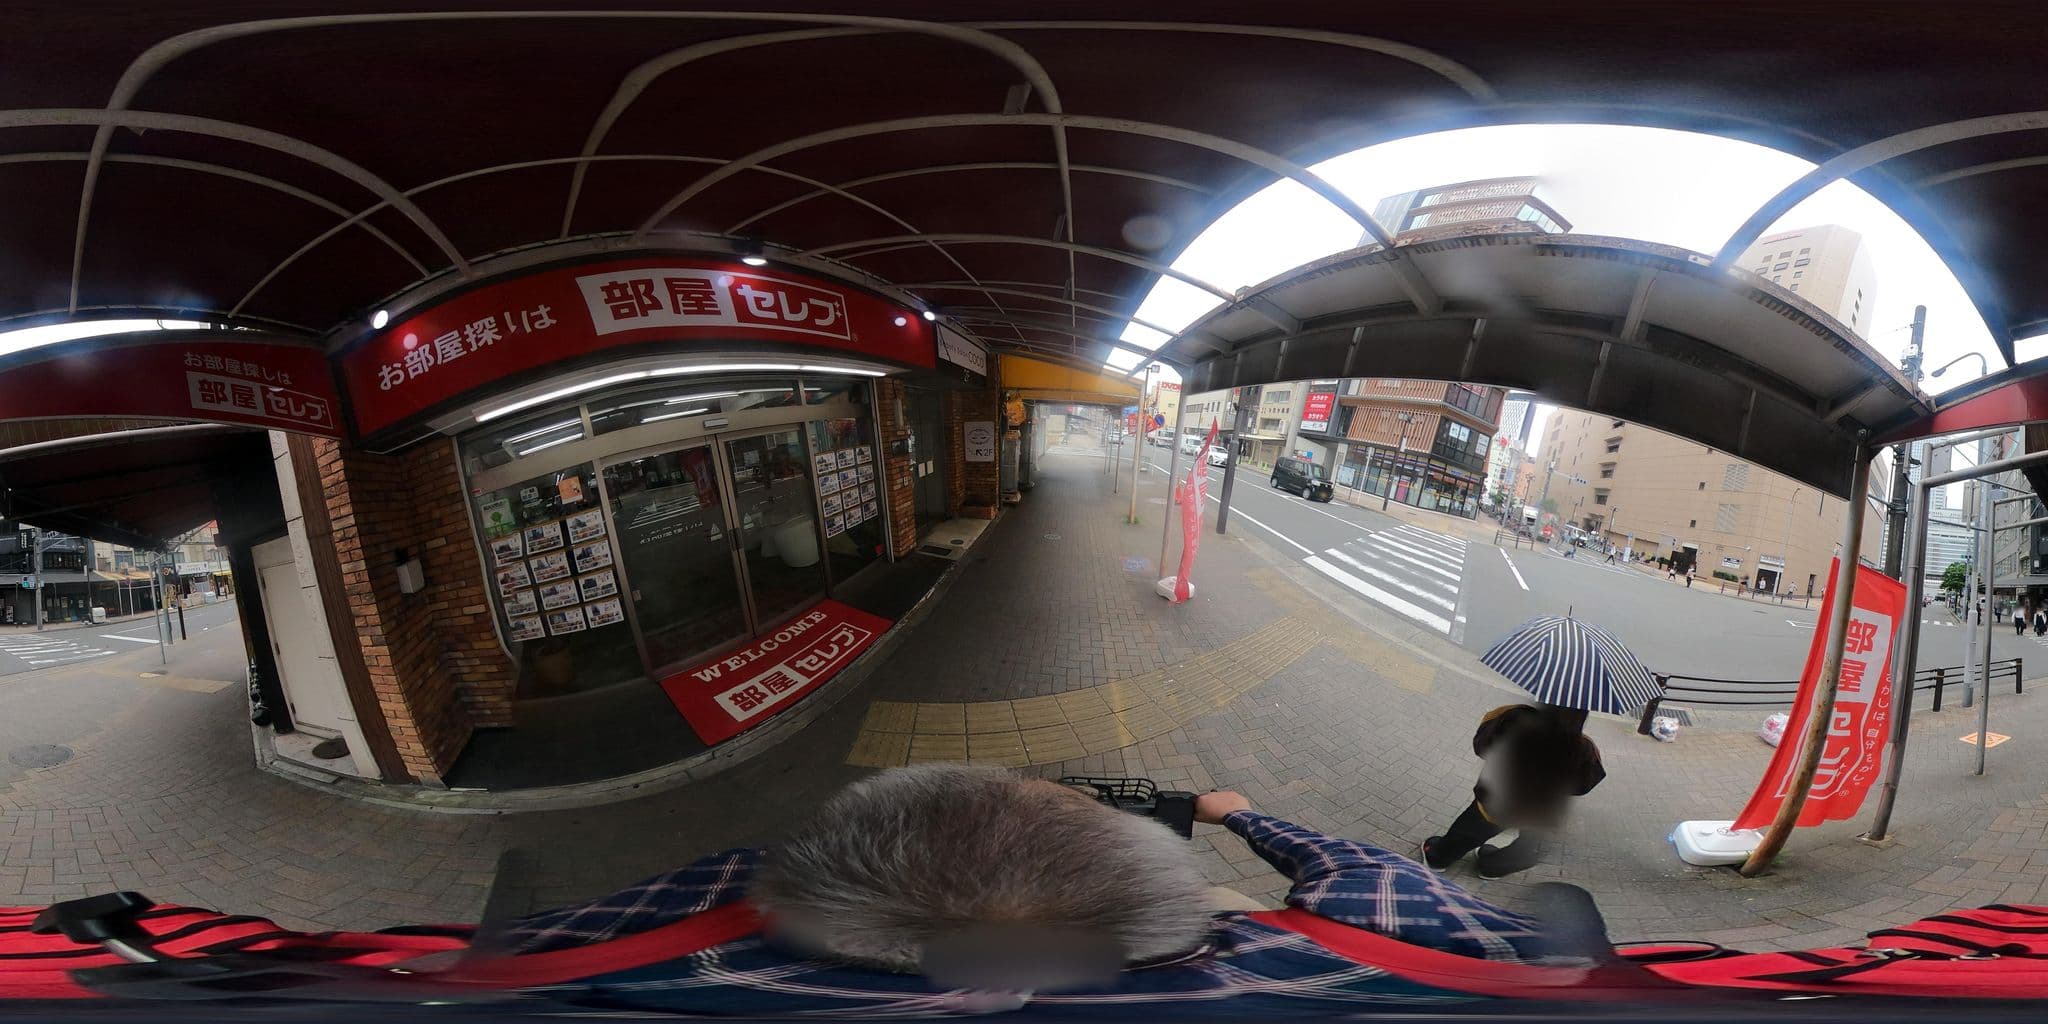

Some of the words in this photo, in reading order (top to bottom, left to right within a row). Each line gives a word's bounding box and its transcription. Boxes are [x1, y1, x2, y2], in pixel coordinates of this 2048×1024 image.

[600, 278, 843, 327] 部屋セレブ
[184, 352, 292, 385] お部屋探しは
[199, 378, 327, 422] 部屋セレブ
[692, 611, 827, 683] WELCOME
[728, 627, 856, 712] 部屋セレブ
